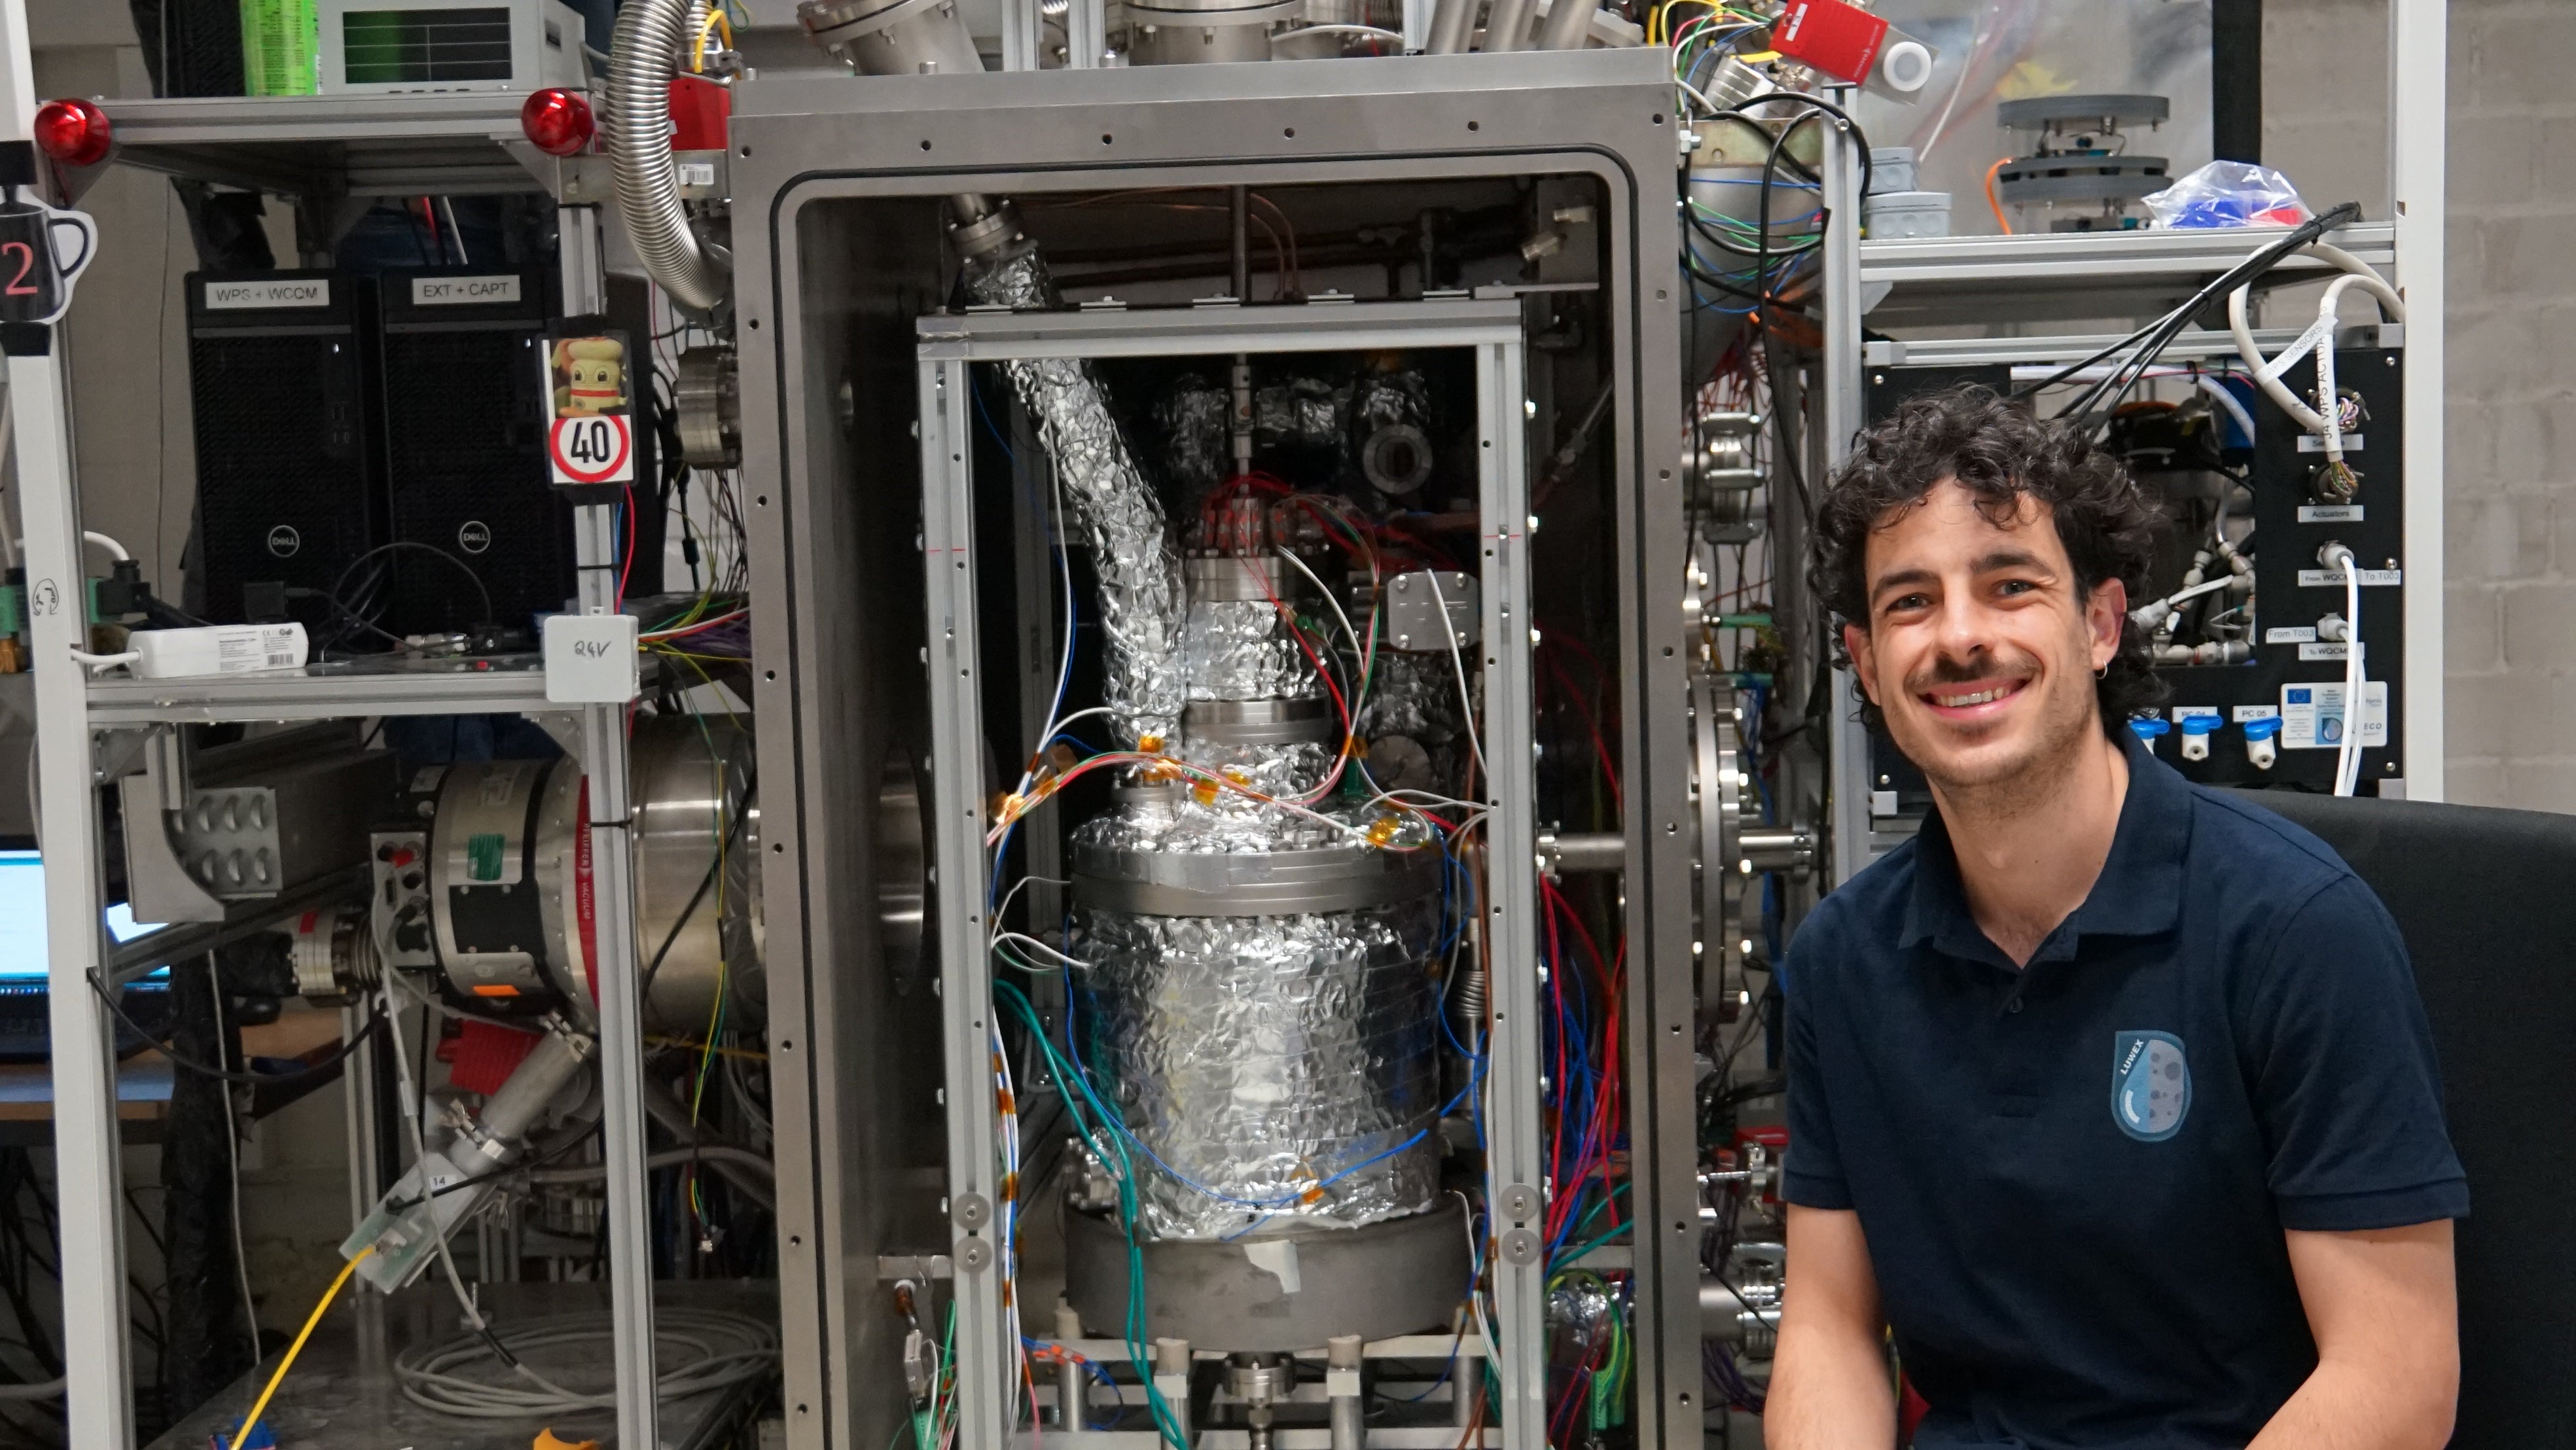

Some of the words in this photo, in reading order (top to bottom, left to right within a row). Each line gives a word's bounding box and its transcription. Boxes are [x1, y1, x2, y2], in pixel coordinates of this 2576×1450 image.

[1, 241, 38, 295] 2
[217, 289, 251, 302] WPS
[423, 284, 452, 297] EXT
[469, 282, 509, 296] CAPT
[2285, 324, 2323, 361] SENSORS
[2319, 387, 2331, 421] WPS
[571, 420, 611, 463] 40
[272, 537, 295, 545] DELL
[463, 533, 488, 541] DELL
[2268, 629, 2290, 638] From
[2120, 1038, 2144, 1075] LUWEX
[433, 1176, 445, 1186] 14
